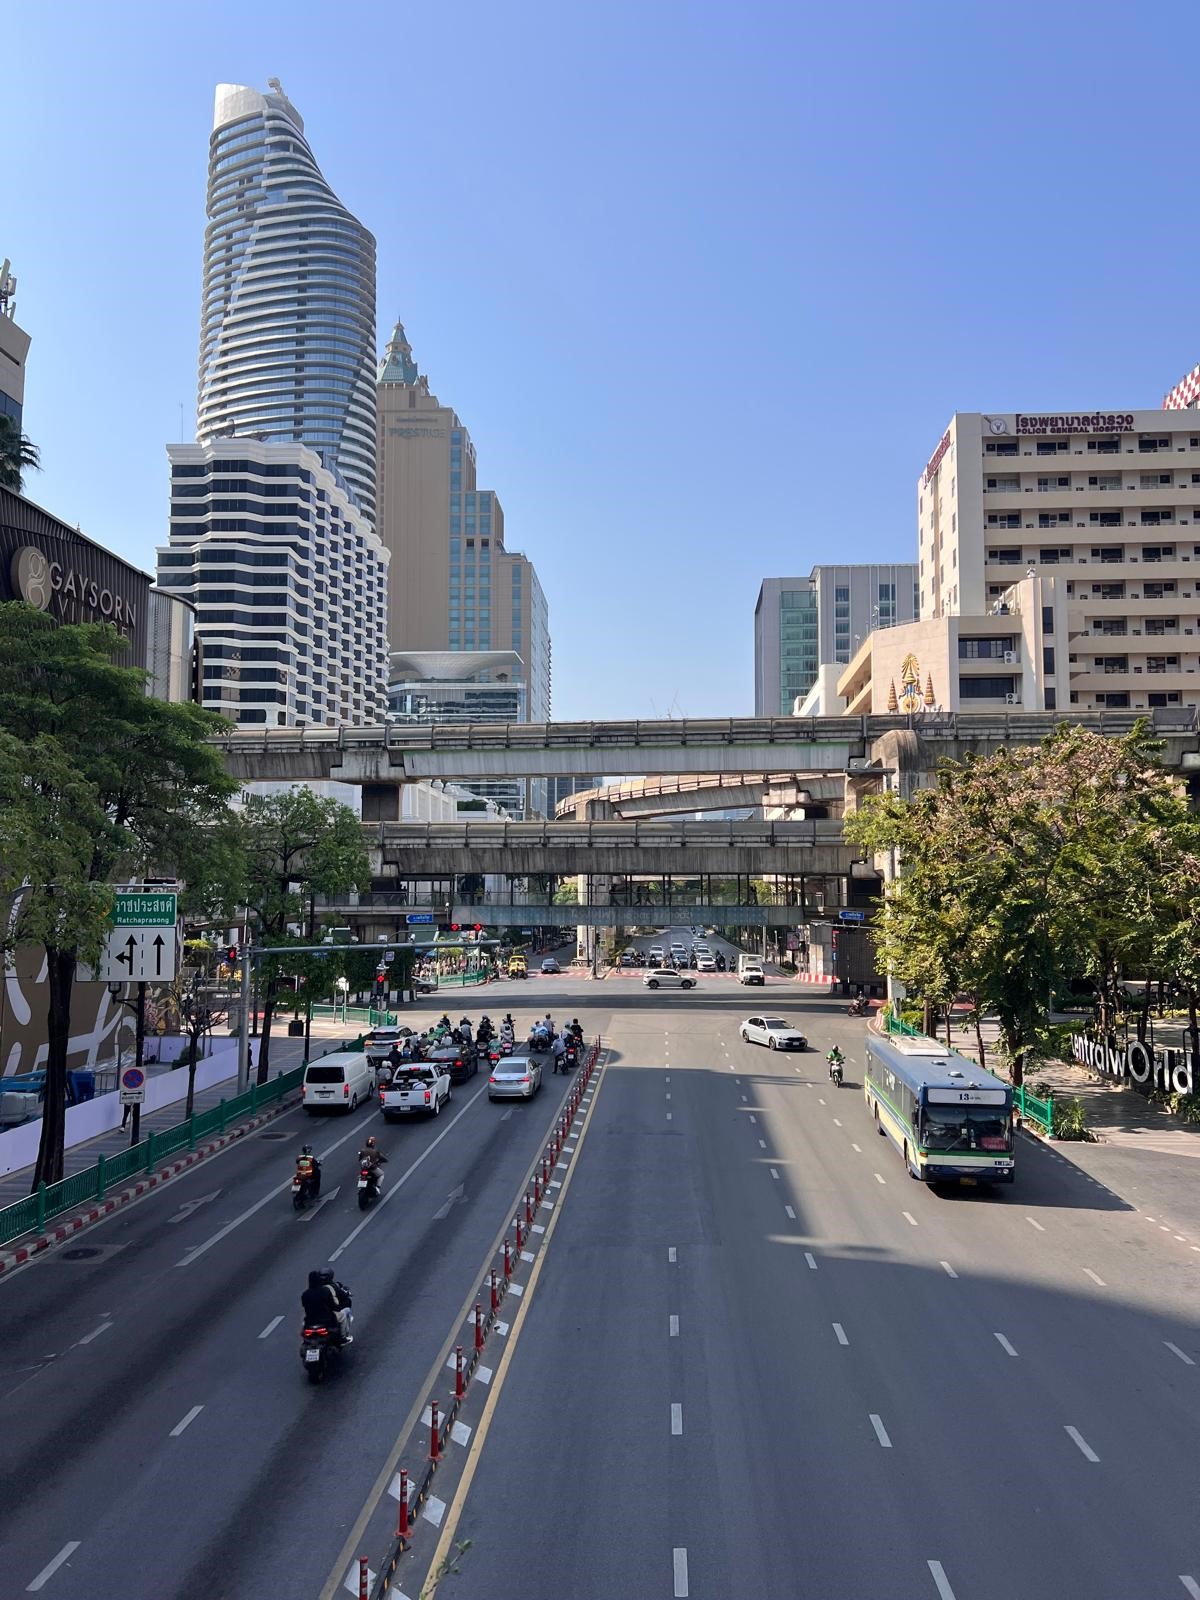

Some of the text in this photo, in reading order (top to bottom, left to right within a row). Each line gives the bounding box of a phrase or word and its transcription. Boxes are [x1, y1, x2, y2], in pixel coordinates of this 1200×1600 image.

[1016, 412, 1134, 428] โรงพยาบาลตำรวจ
[1093, 425, 1135, 433] HOSPITAL
[50, 562, 136, 627] GAYSORN
[115, 896, 173, 912] ราชประสงค์
[959, 1093, 970, 1101] 13
